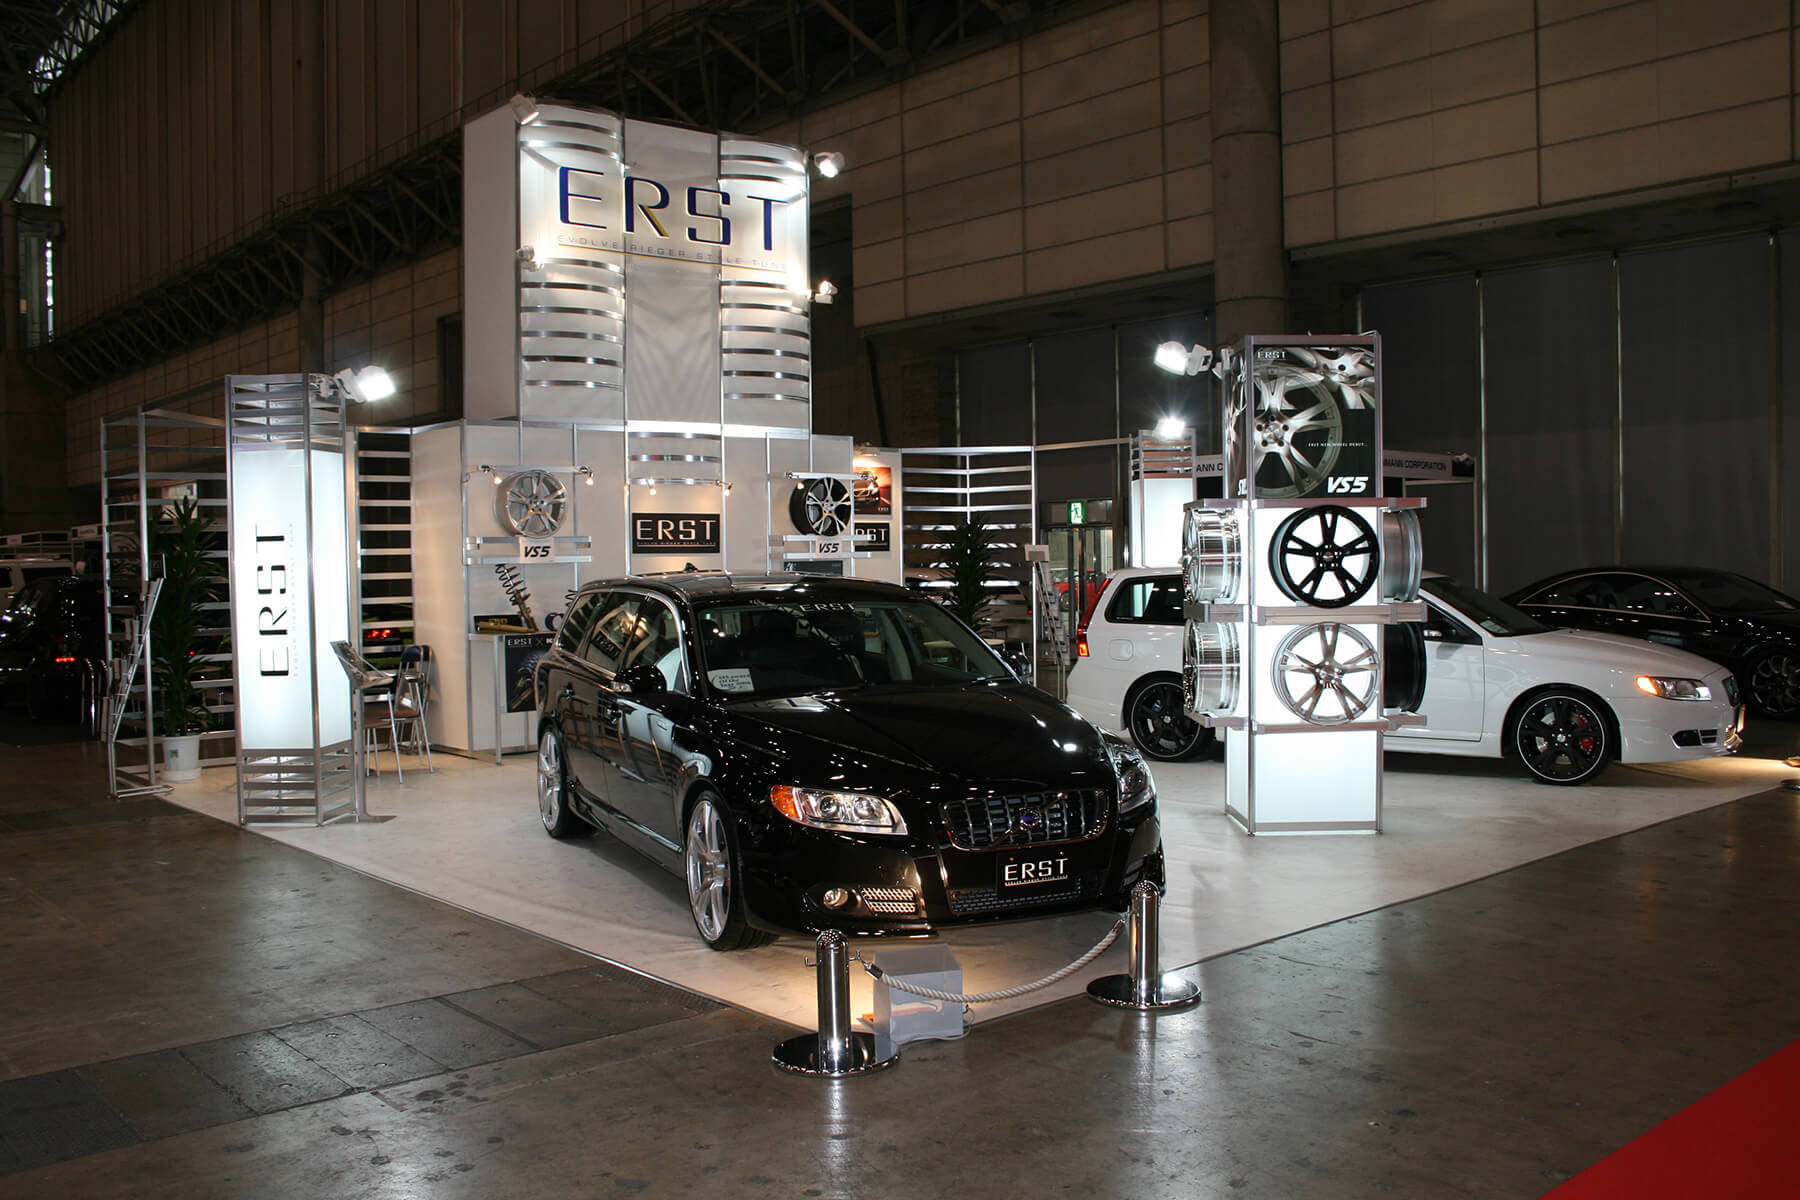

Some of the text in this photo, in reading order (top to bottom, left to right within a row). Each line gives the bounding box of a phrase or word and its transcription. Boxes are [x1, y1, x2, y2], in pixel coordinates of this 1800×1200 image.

[559, 166, 789, 251] ERST
[557, 232, 617, 249] EVOLVE
[1257, 351, 1286, 360] ERST
[1327, 476, 1368, 493] VS5
[636, 519, 717, 540] ERST
[524, 546, 551, 558] VS5
[819, 543, 839, 553] VS5
[256, 523, 289, 677] ERST
[800, 603, 856, 612] ERST
[507, 638, 532, 646] ERST
[1004, 858, 1069, 881] ERST
